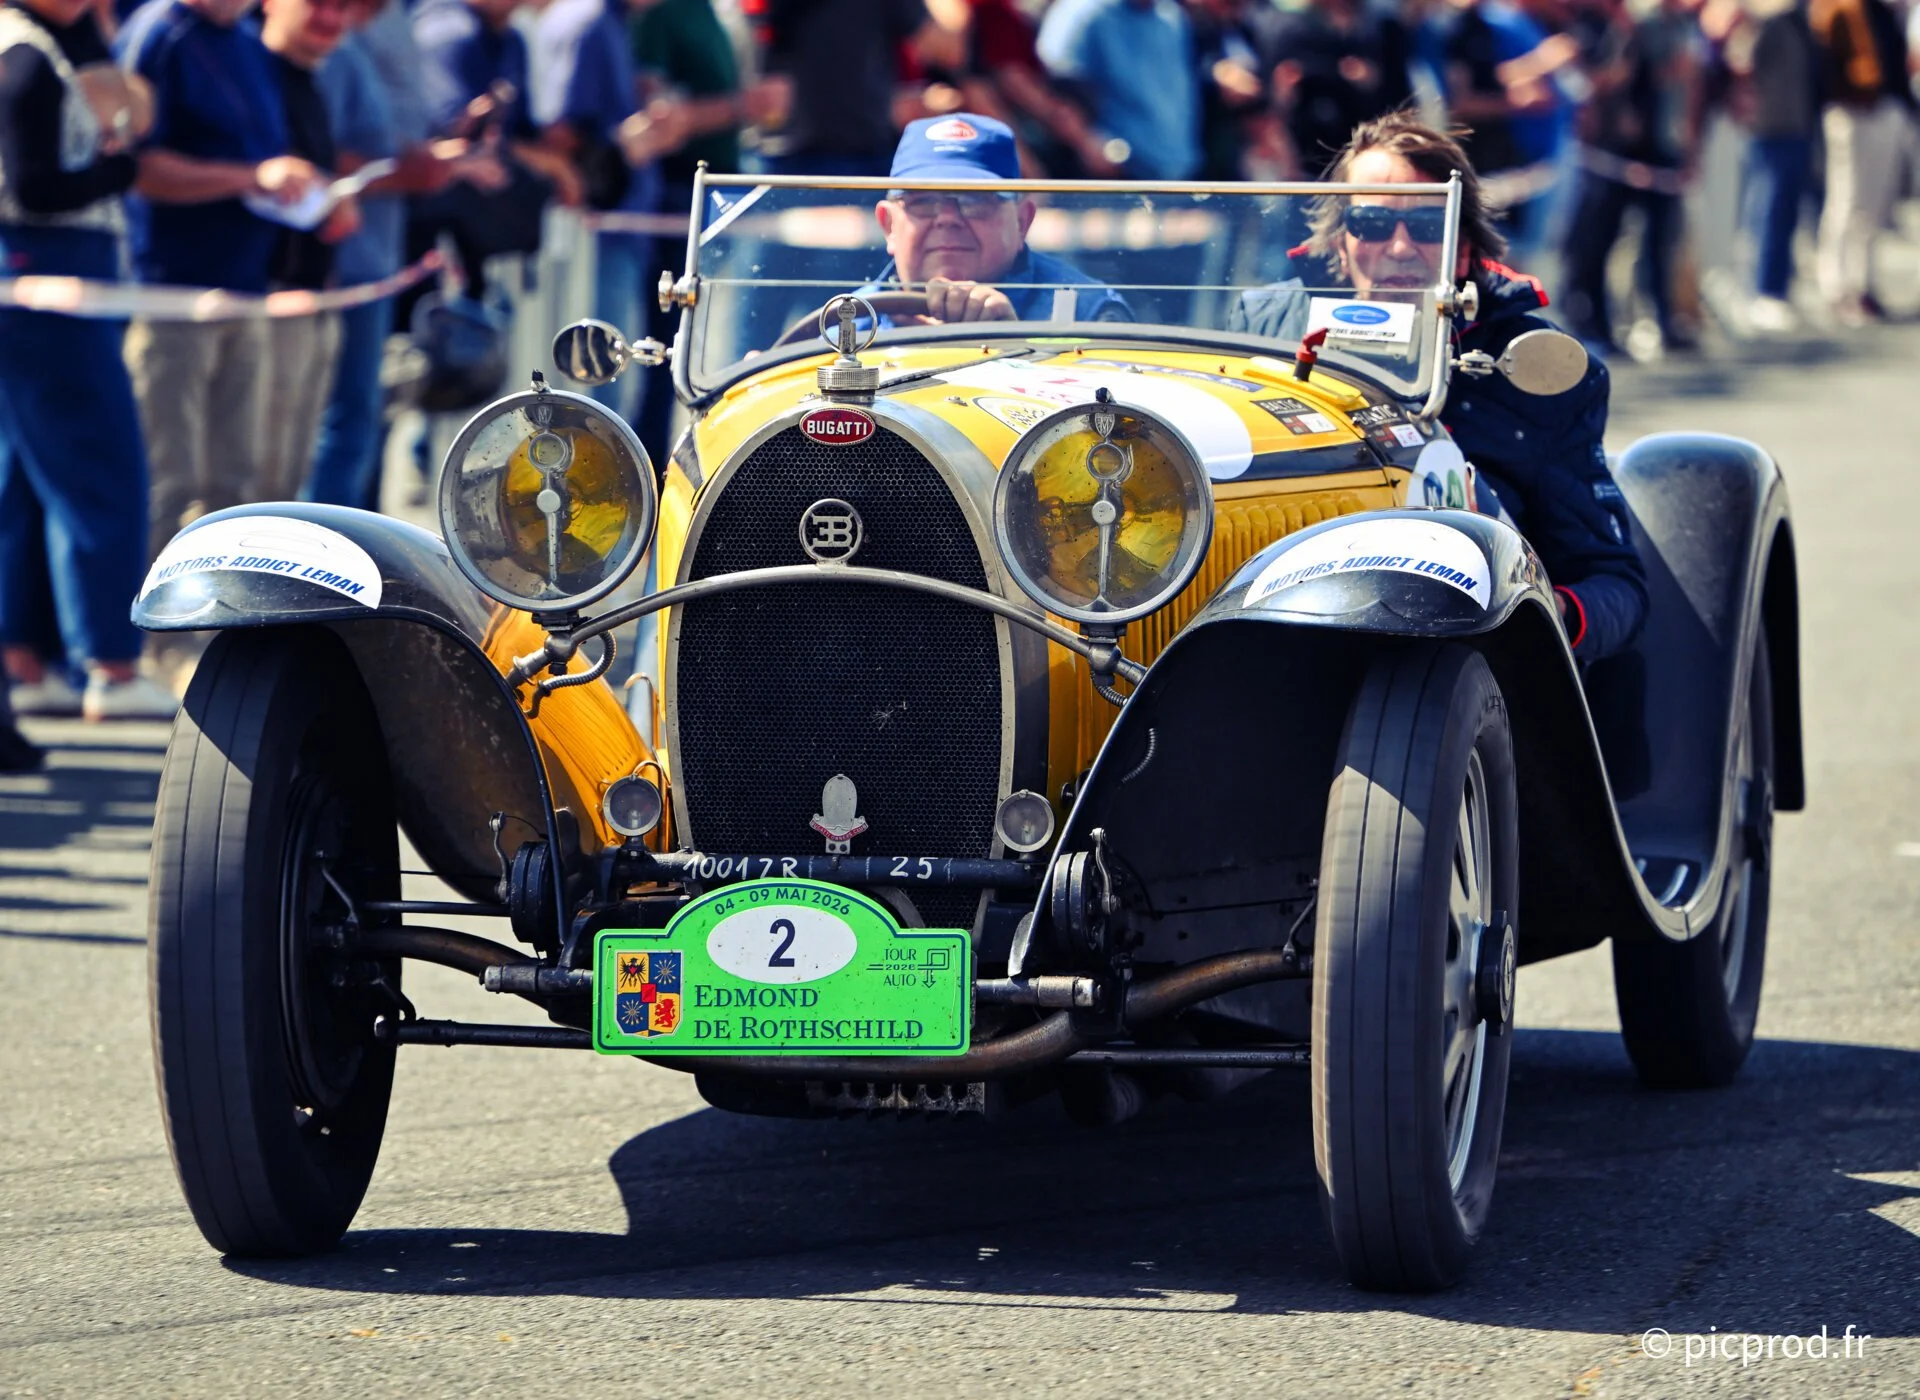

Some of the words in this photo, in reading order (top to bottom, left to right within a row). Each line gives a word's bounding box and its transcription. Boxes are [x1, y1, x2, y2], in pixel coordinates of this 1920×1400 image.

[806, 420, 868, 436] BUGATTI
[157, 555, 226, 580] MOTORS
[229, 555, 303, 573] ADDICT
[300, 567, 366, 595] LEMAN
[1262, 560, 1338, 595] MOTORS
[1343, 555, 1412, 569] ADDICT
[1414, 559, 1479, 591] LEMAN
[683, 856, 749, 880] 1001
[889, 856, 939, 880] 25
[714, 898, 735, 915] 04
[749, 888, 769, 902] 09
[775, 888, 807, 901] MAI
[811, 891, 850, 915] 2026
[767, 918, 796, 968] 2
[884, 948, 917, 961] TOUR
[883, 974, 917, 987] AUTO
[694, 984, 819, 1008] EDMOND
[694, 1020, 731, 1040] DE
[739, 1016, 924, 1040] ROTHSCHILD
